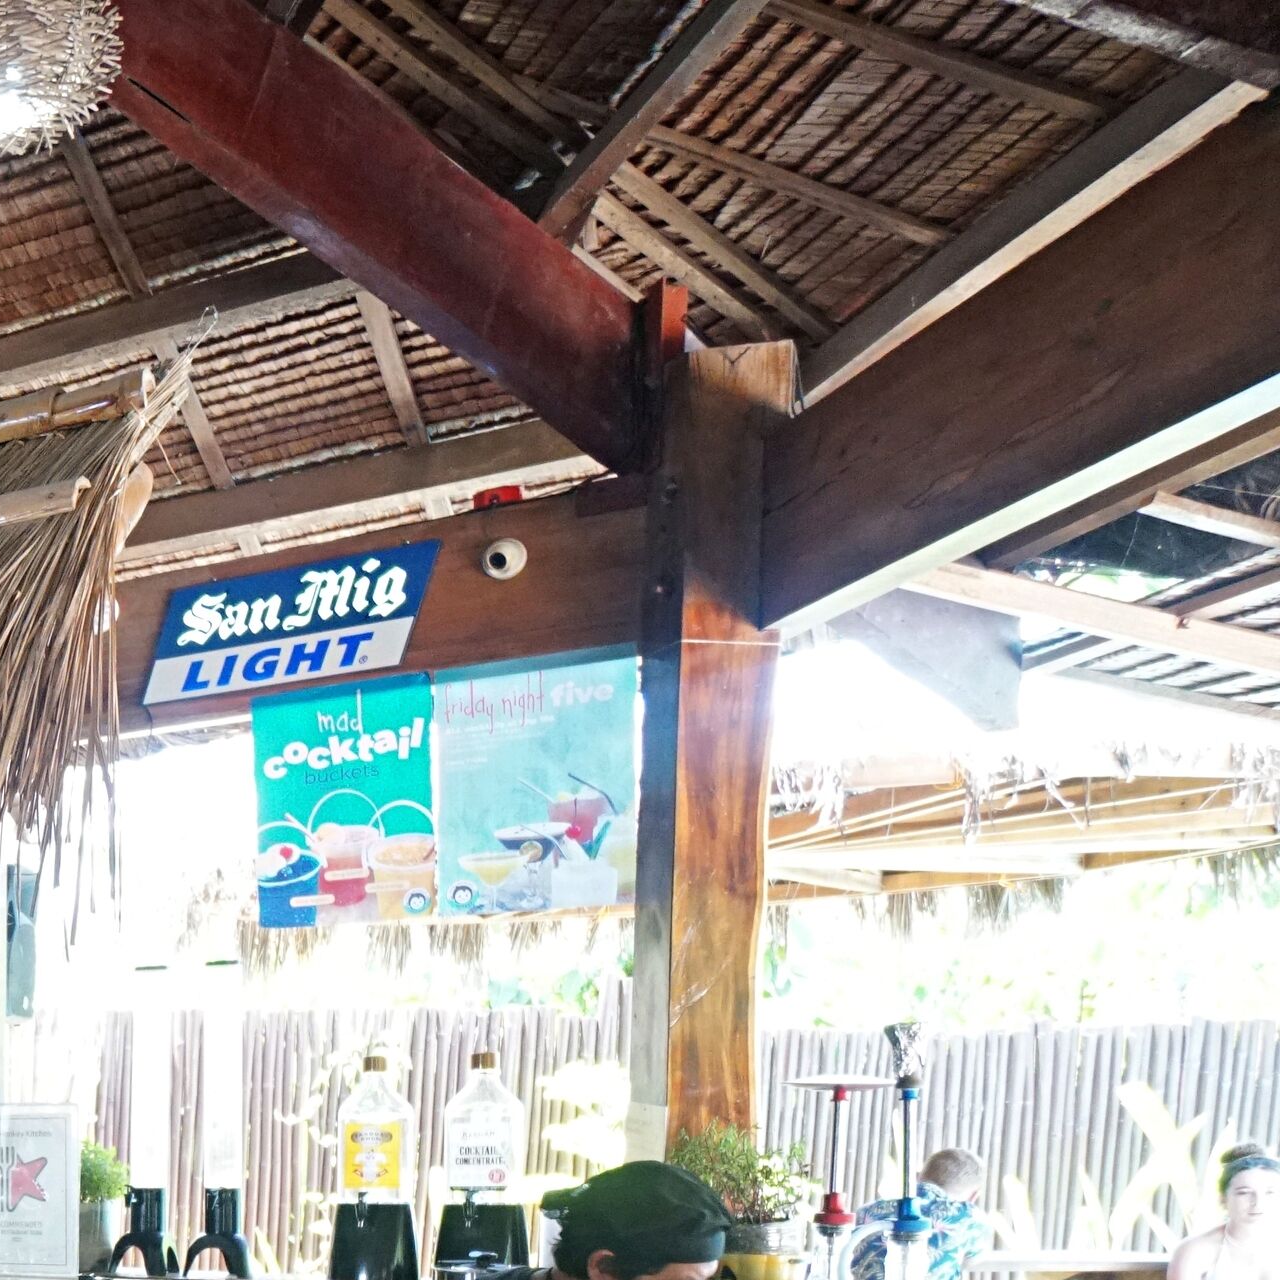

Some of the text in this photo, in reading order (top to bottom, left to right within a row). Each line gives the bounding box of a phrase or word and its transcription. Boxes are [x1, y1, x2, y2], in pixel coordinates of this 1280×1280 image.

[176, 557, 408, 647] San Mig
[181, 631, 374, 693] LIGHT
[316, 688, 364, 734] mad
[445, 679, 494, 735] friday
[501, 670, 544, 727] night
[551, 680, 615, 707] five
[263, 716, 425, 780] cocktail
[304, 764, 380, 785] buckets
[459, 1146, 497, 1156] COCKTAIL
